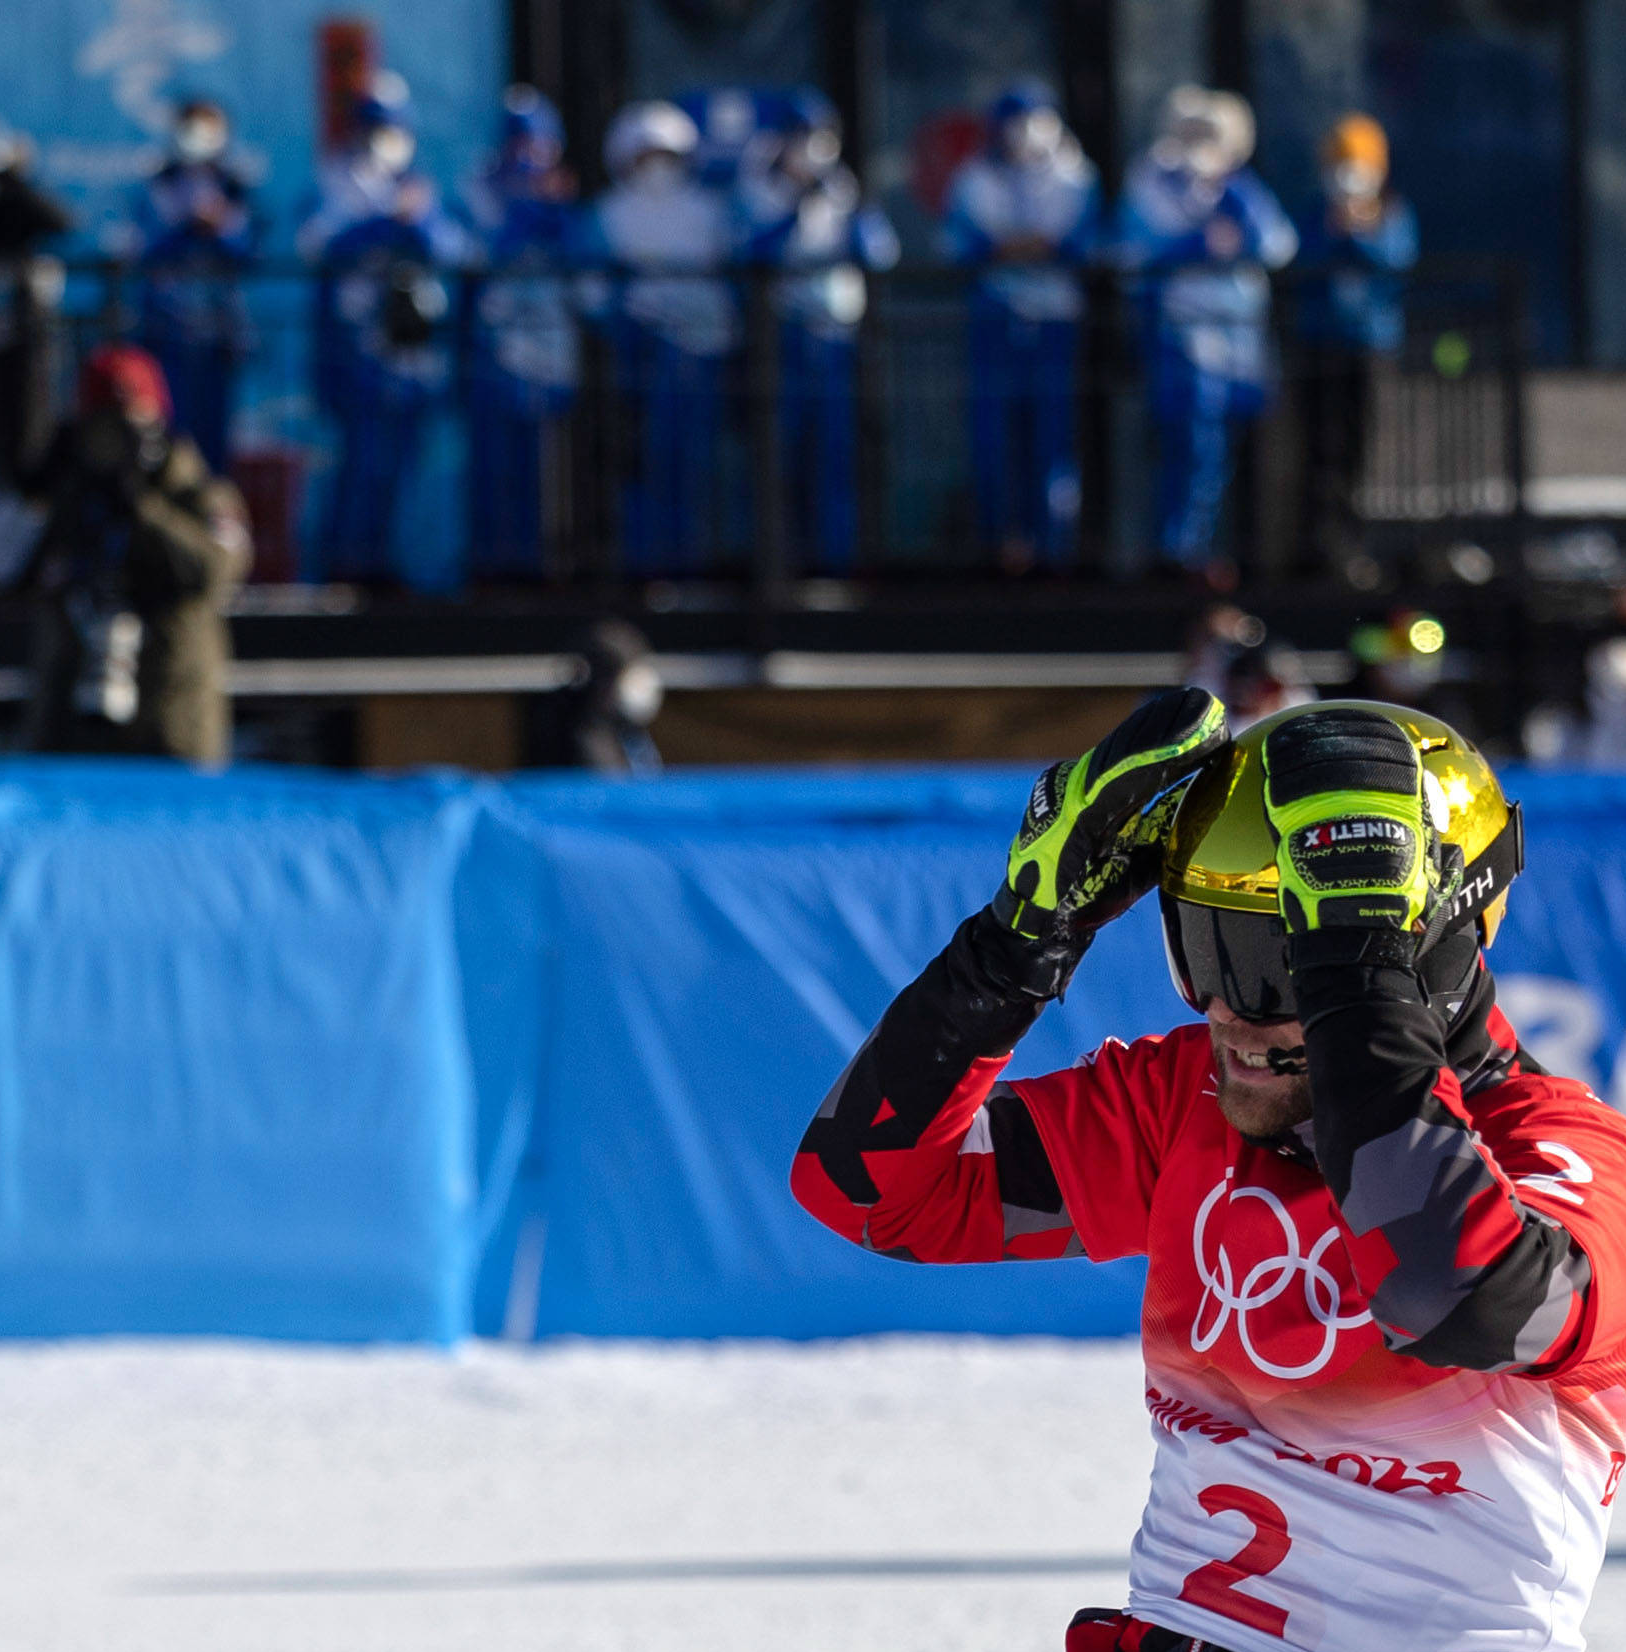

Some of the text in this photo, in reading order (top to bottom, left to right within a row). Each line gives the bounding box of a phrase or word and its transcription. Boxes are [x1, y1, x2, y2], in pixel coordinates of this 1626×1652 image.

[1449, 866, 1494, 920] ITH
[1515, 1140, 1593, 1206] 2
[1176, 1483, 1293, 1639] 2
